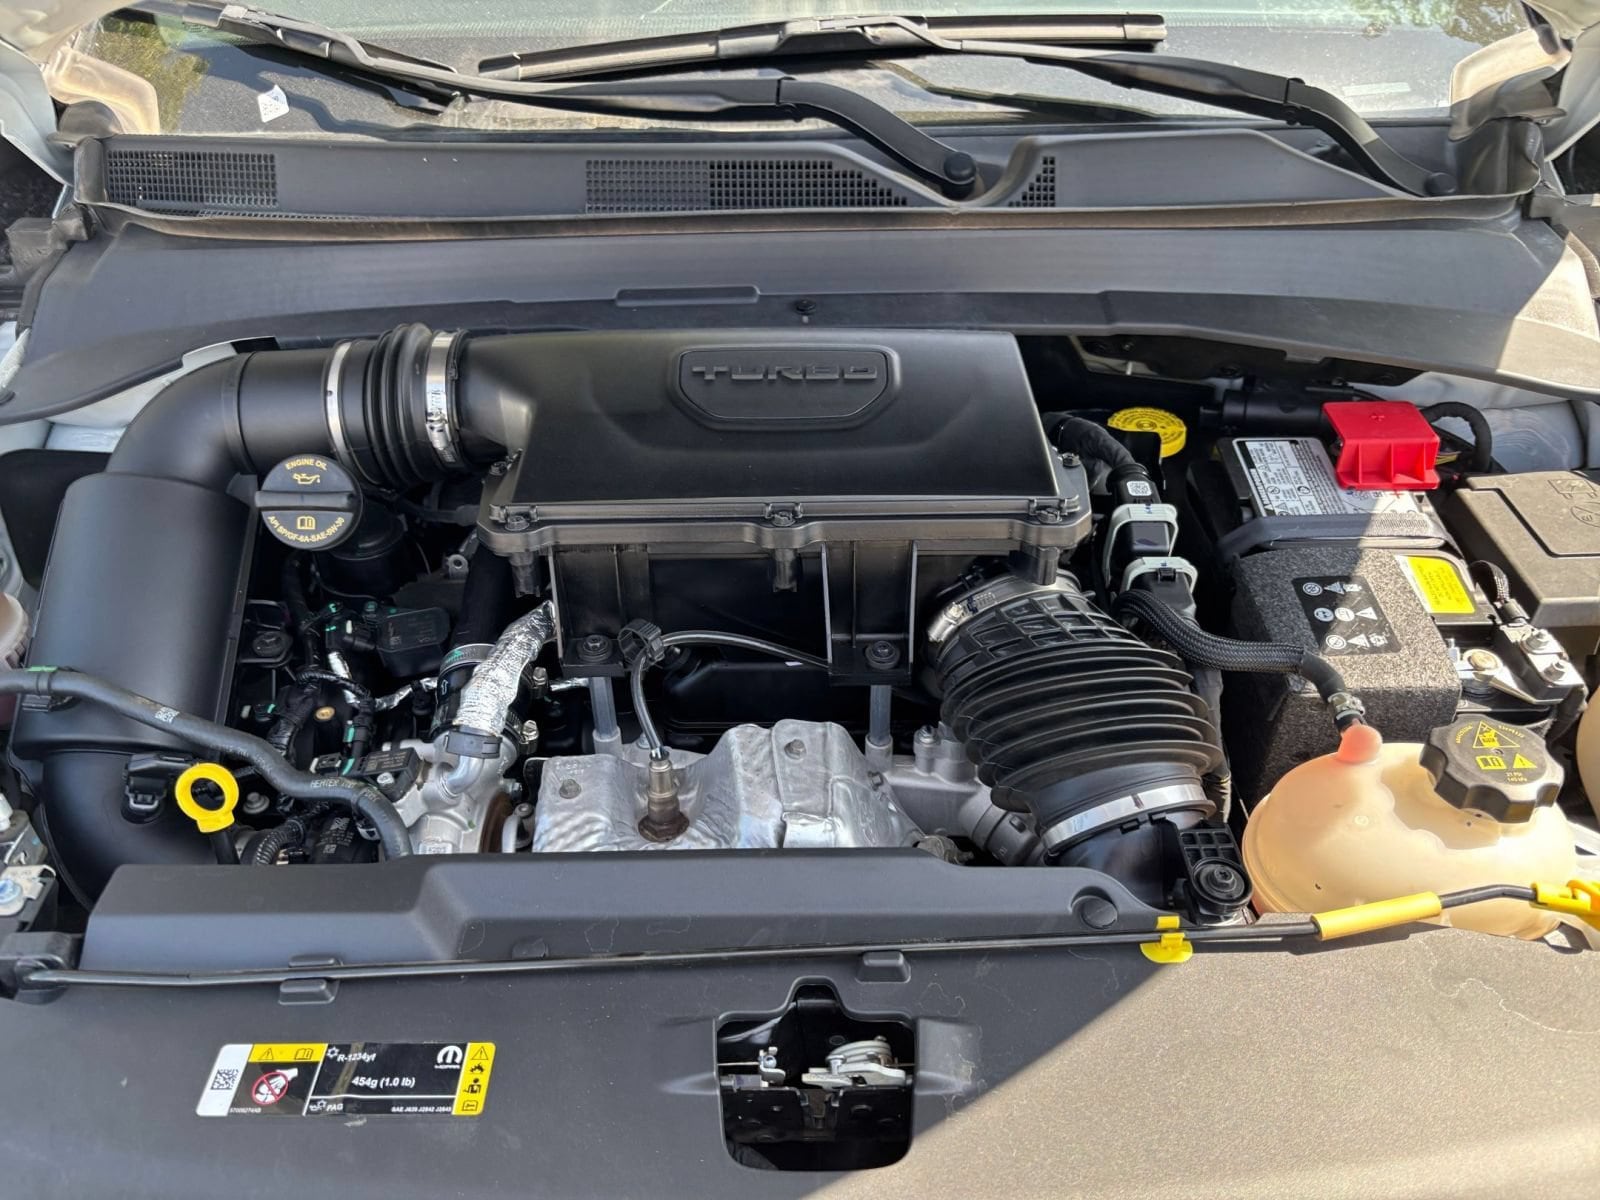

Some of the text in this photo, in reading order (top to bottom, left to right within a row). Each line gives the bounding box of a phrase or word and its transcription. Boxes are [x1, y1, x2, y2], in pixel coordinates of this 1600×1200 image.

[691, 364, 878, 381] TURBO
[286, 459, 327, 470] ENGINE OIL
[268, 516, 278, 528] API
[337, 1052, 377, 1063] R-1234yf
[351, 1076, 416, 1089] 454g (1.0 lb)
[325, 1103, 344, 1112] PAG
